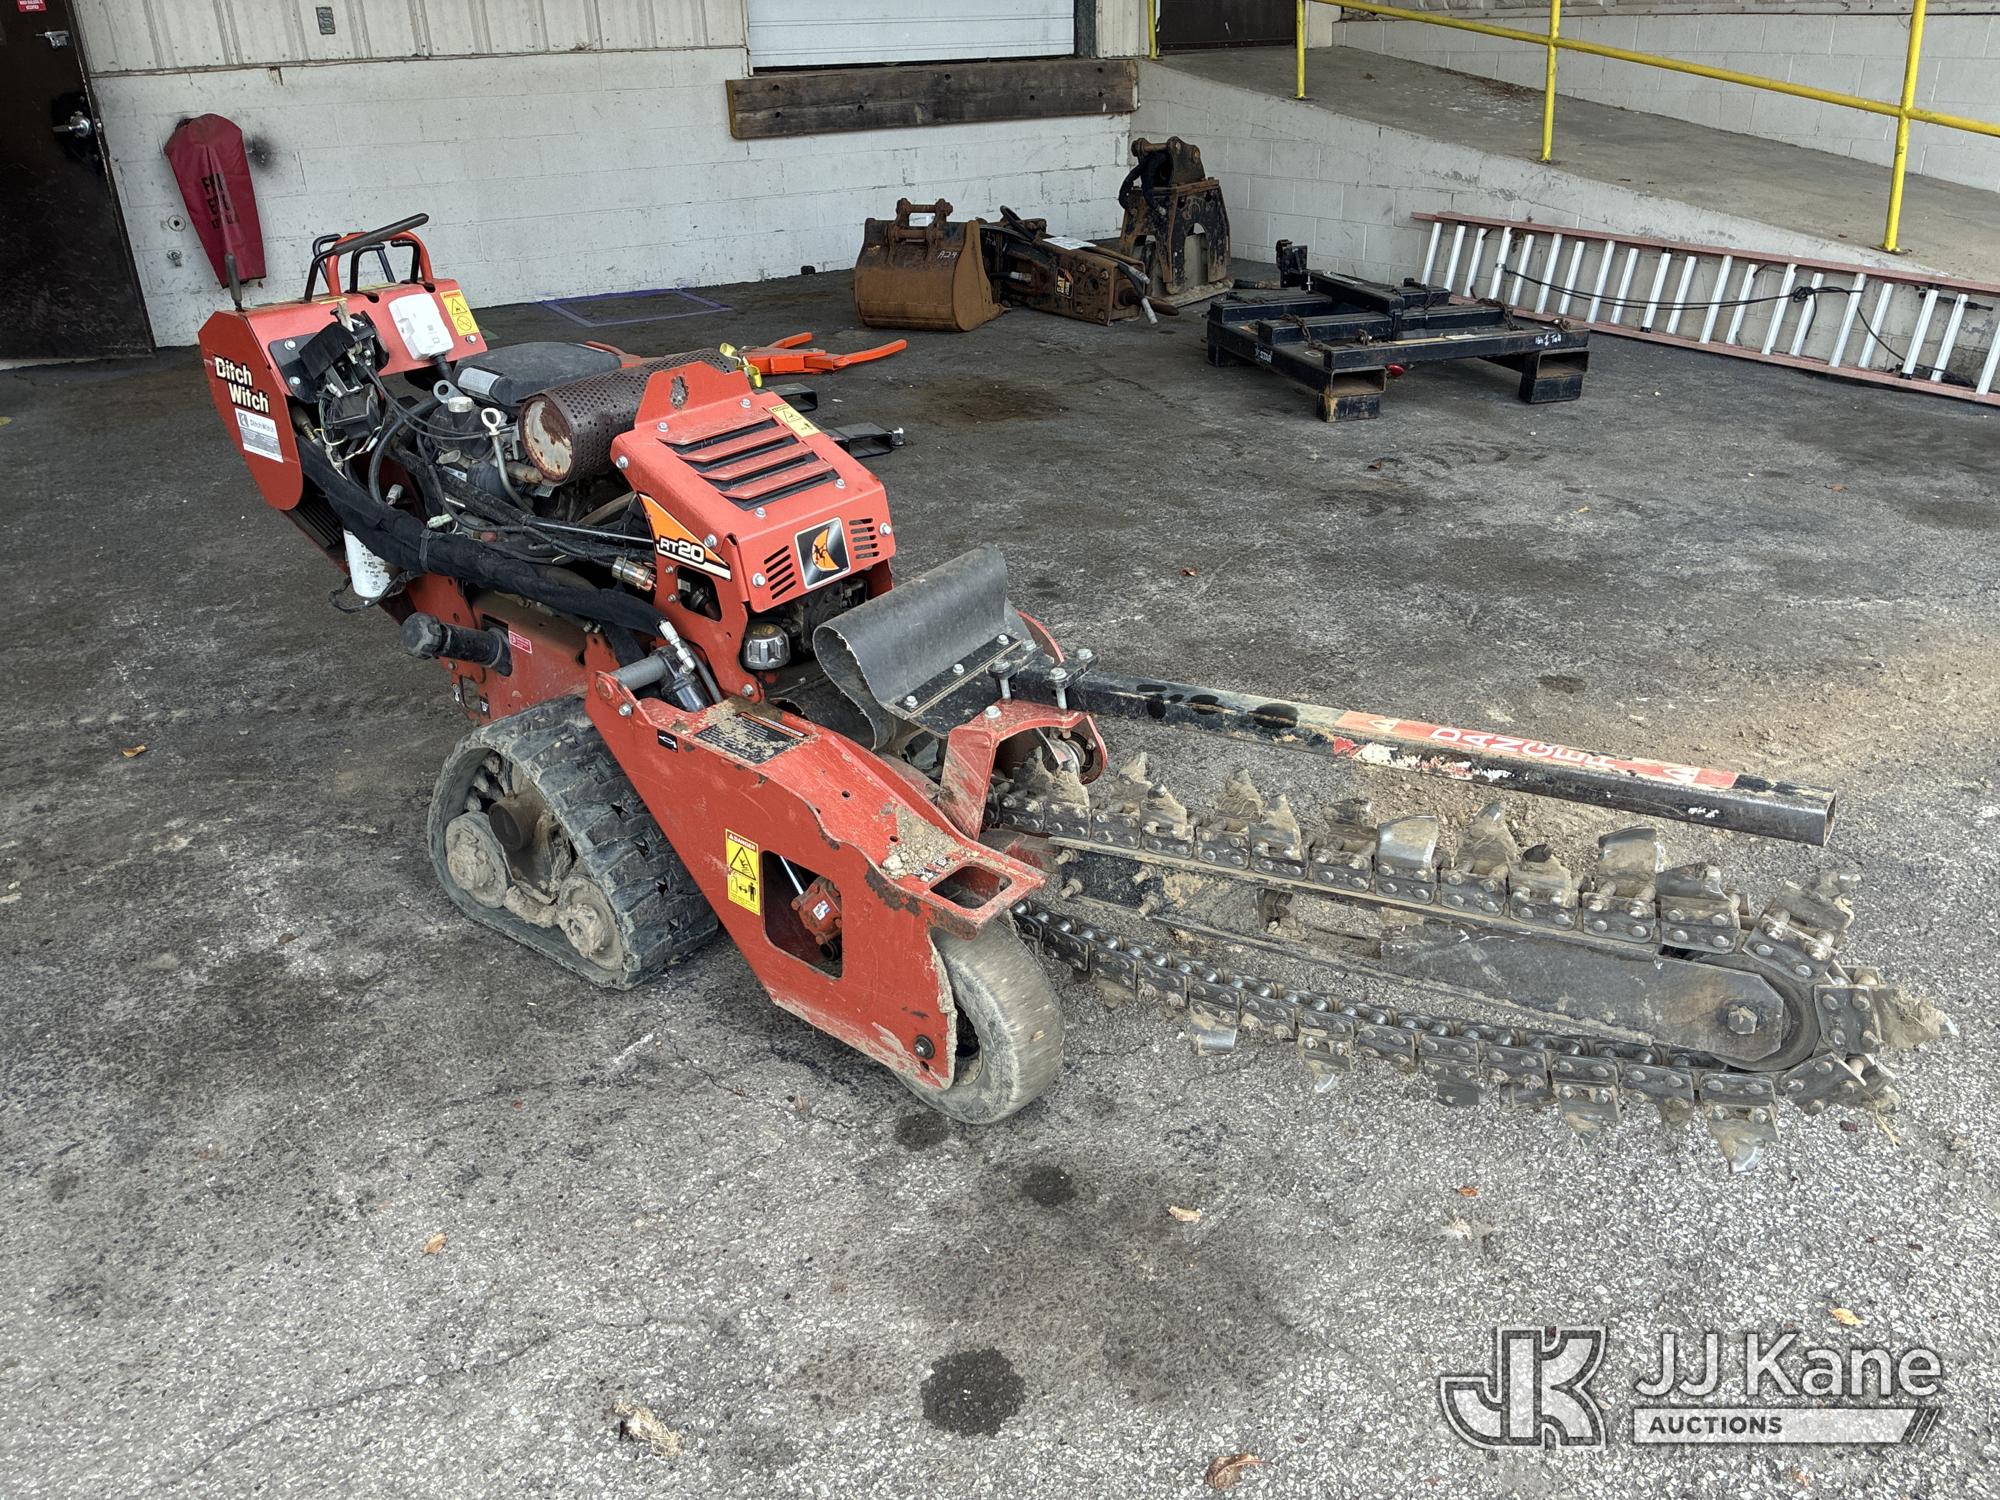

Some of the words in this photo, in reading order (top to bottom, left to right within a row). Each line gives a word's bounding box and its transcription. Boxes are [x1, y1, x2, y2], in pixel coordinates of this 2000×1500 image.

[214, 356, 253, 387] Ditch
[228, 382, 270, 413] Witch
[660, 537, 705, 563] RT20
